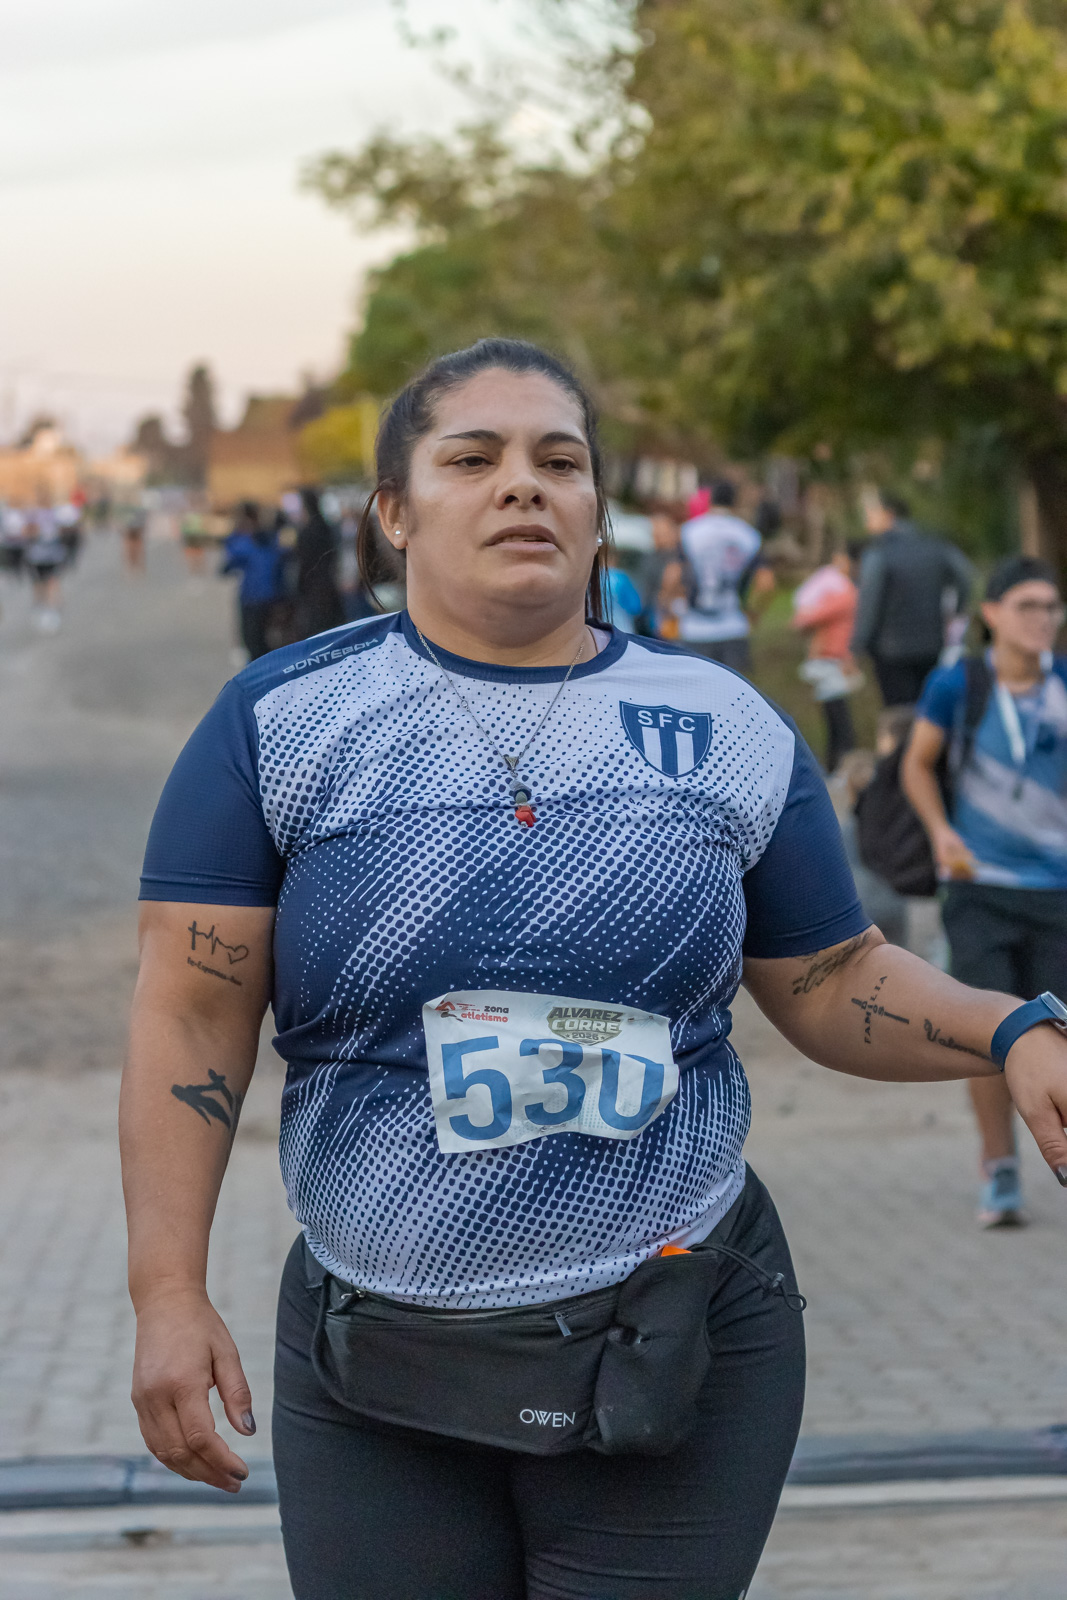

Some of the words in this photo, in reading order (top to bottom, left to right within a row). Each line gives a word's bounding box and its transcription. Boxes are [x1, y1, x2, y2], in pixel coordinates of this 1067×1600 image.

[283, 638, 379, 674] BONTEBOK
[637, 710, 696, 732] SFC
[461, 1011, 509, 1023] atletismo
[483, 1005, 510, 1014] zona
[549, 1007, 624, 1022] ALVAREZ
[551, 1019, 620, 1034] CORRE
[441, 1036, 665, 1140] 530
[519, 1408, 576, 1427] OWEN
